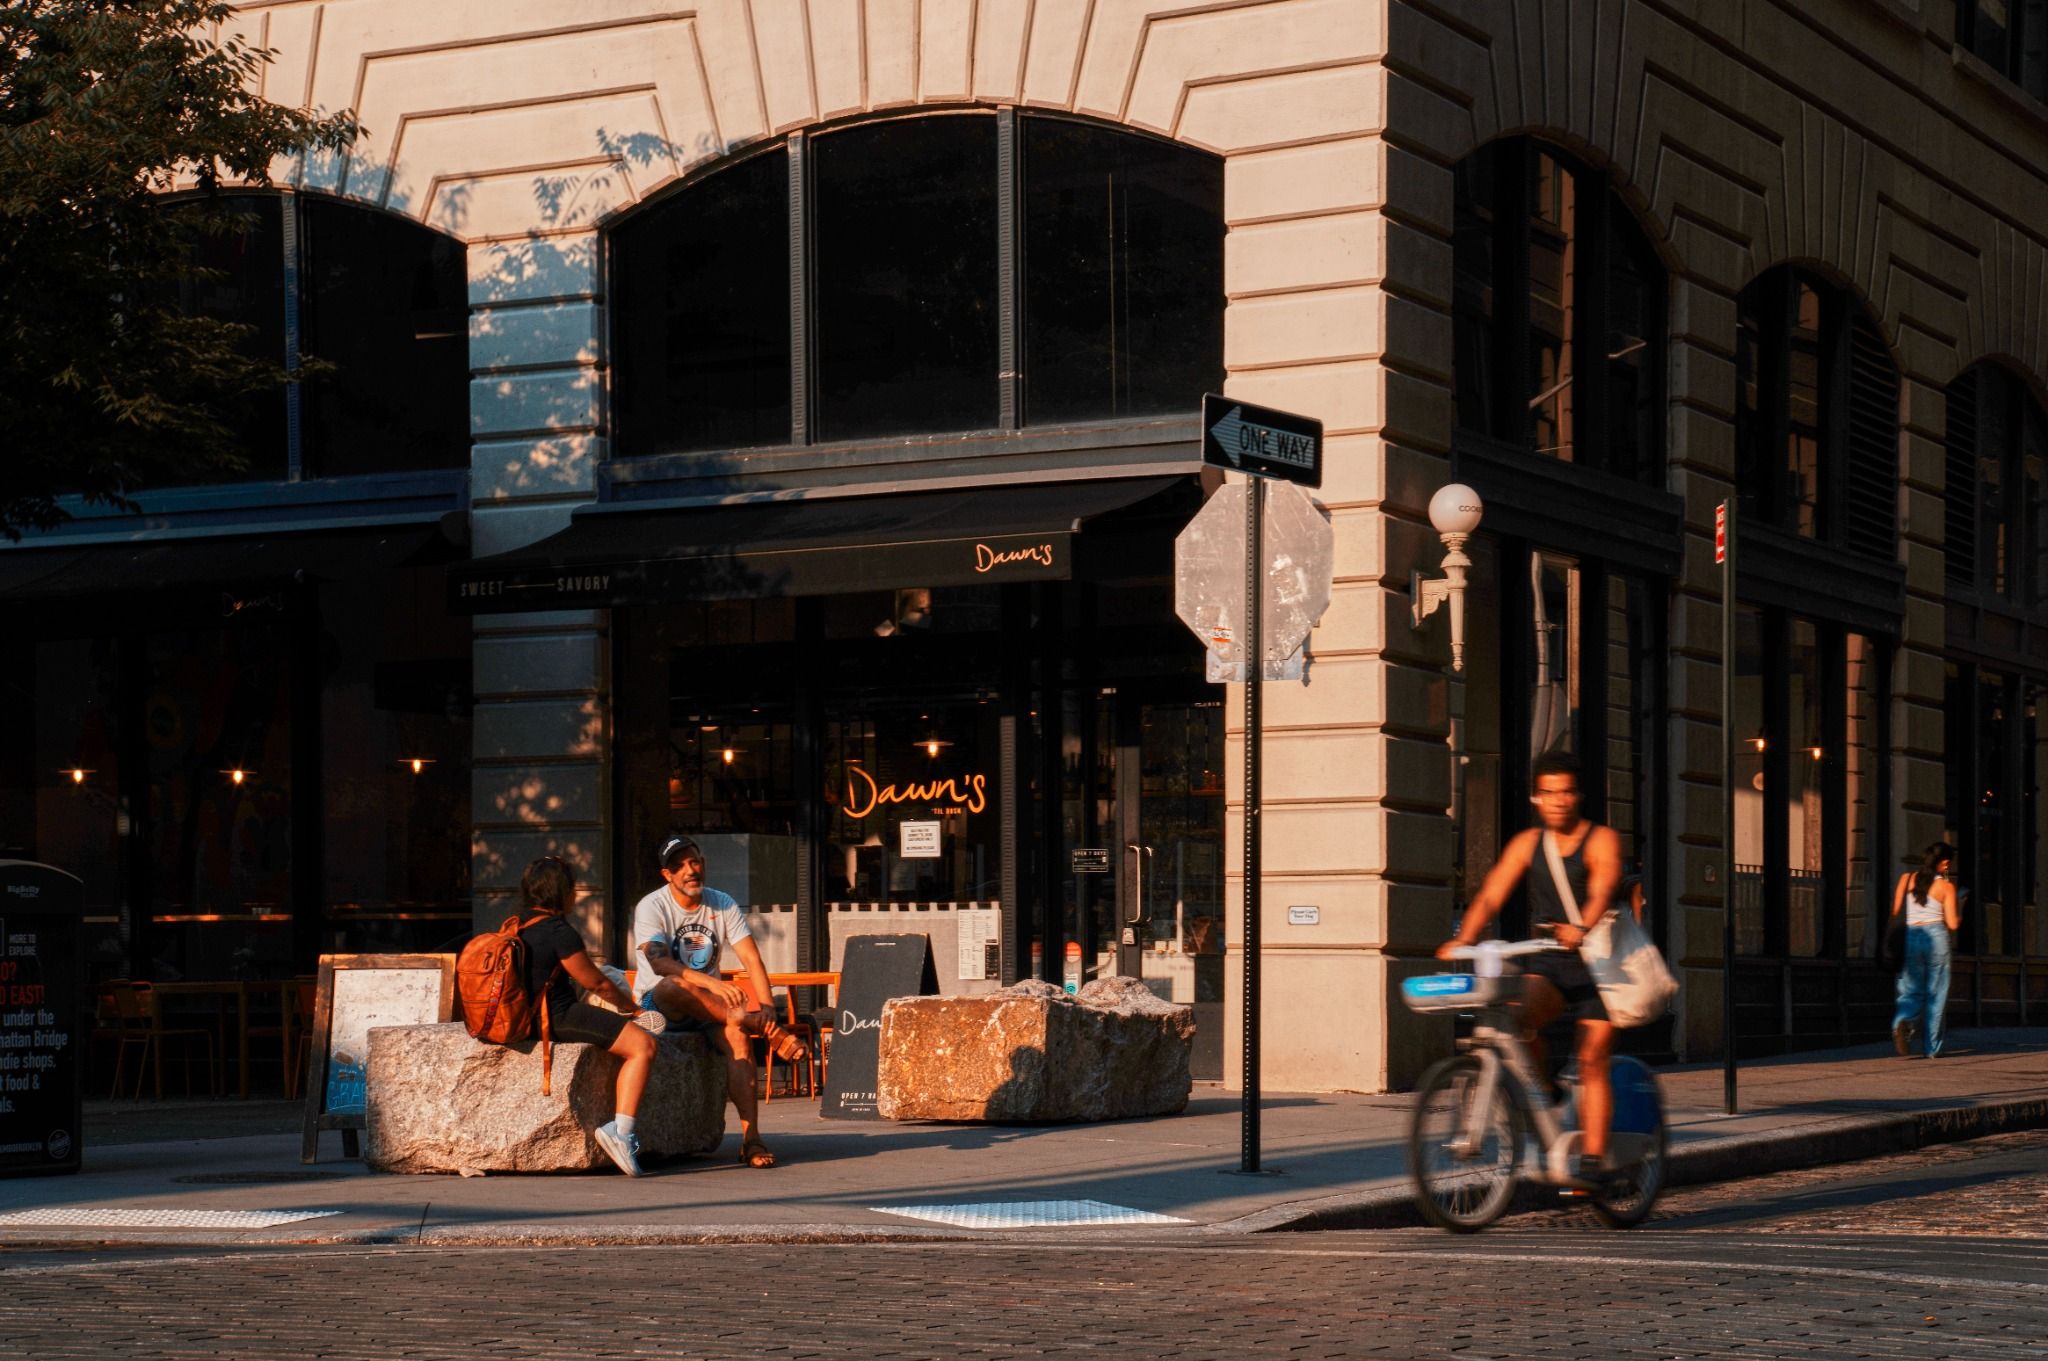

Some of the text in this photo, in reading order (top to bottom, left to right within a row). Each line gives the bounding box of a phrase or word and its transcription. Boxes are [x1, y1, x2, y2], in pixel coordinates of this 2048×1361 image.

[1240, 424, 1310, 463] ONE WAY
[975, 543, 1053, 572] Dawn's
[460, 576, 610, 597] SWEET SAVORY
[842, 766, 986, 818] Dawn's
[10, 984, 45, 1005] EAST!
[3, 1009, 54, 1026] under the
[34, 1030, 68, 1050] Bridge
[6, 1073, 30, 1091] food
[32, 1073, 41, 1090] &
[841, 1092, 859, 1100] OPEN
